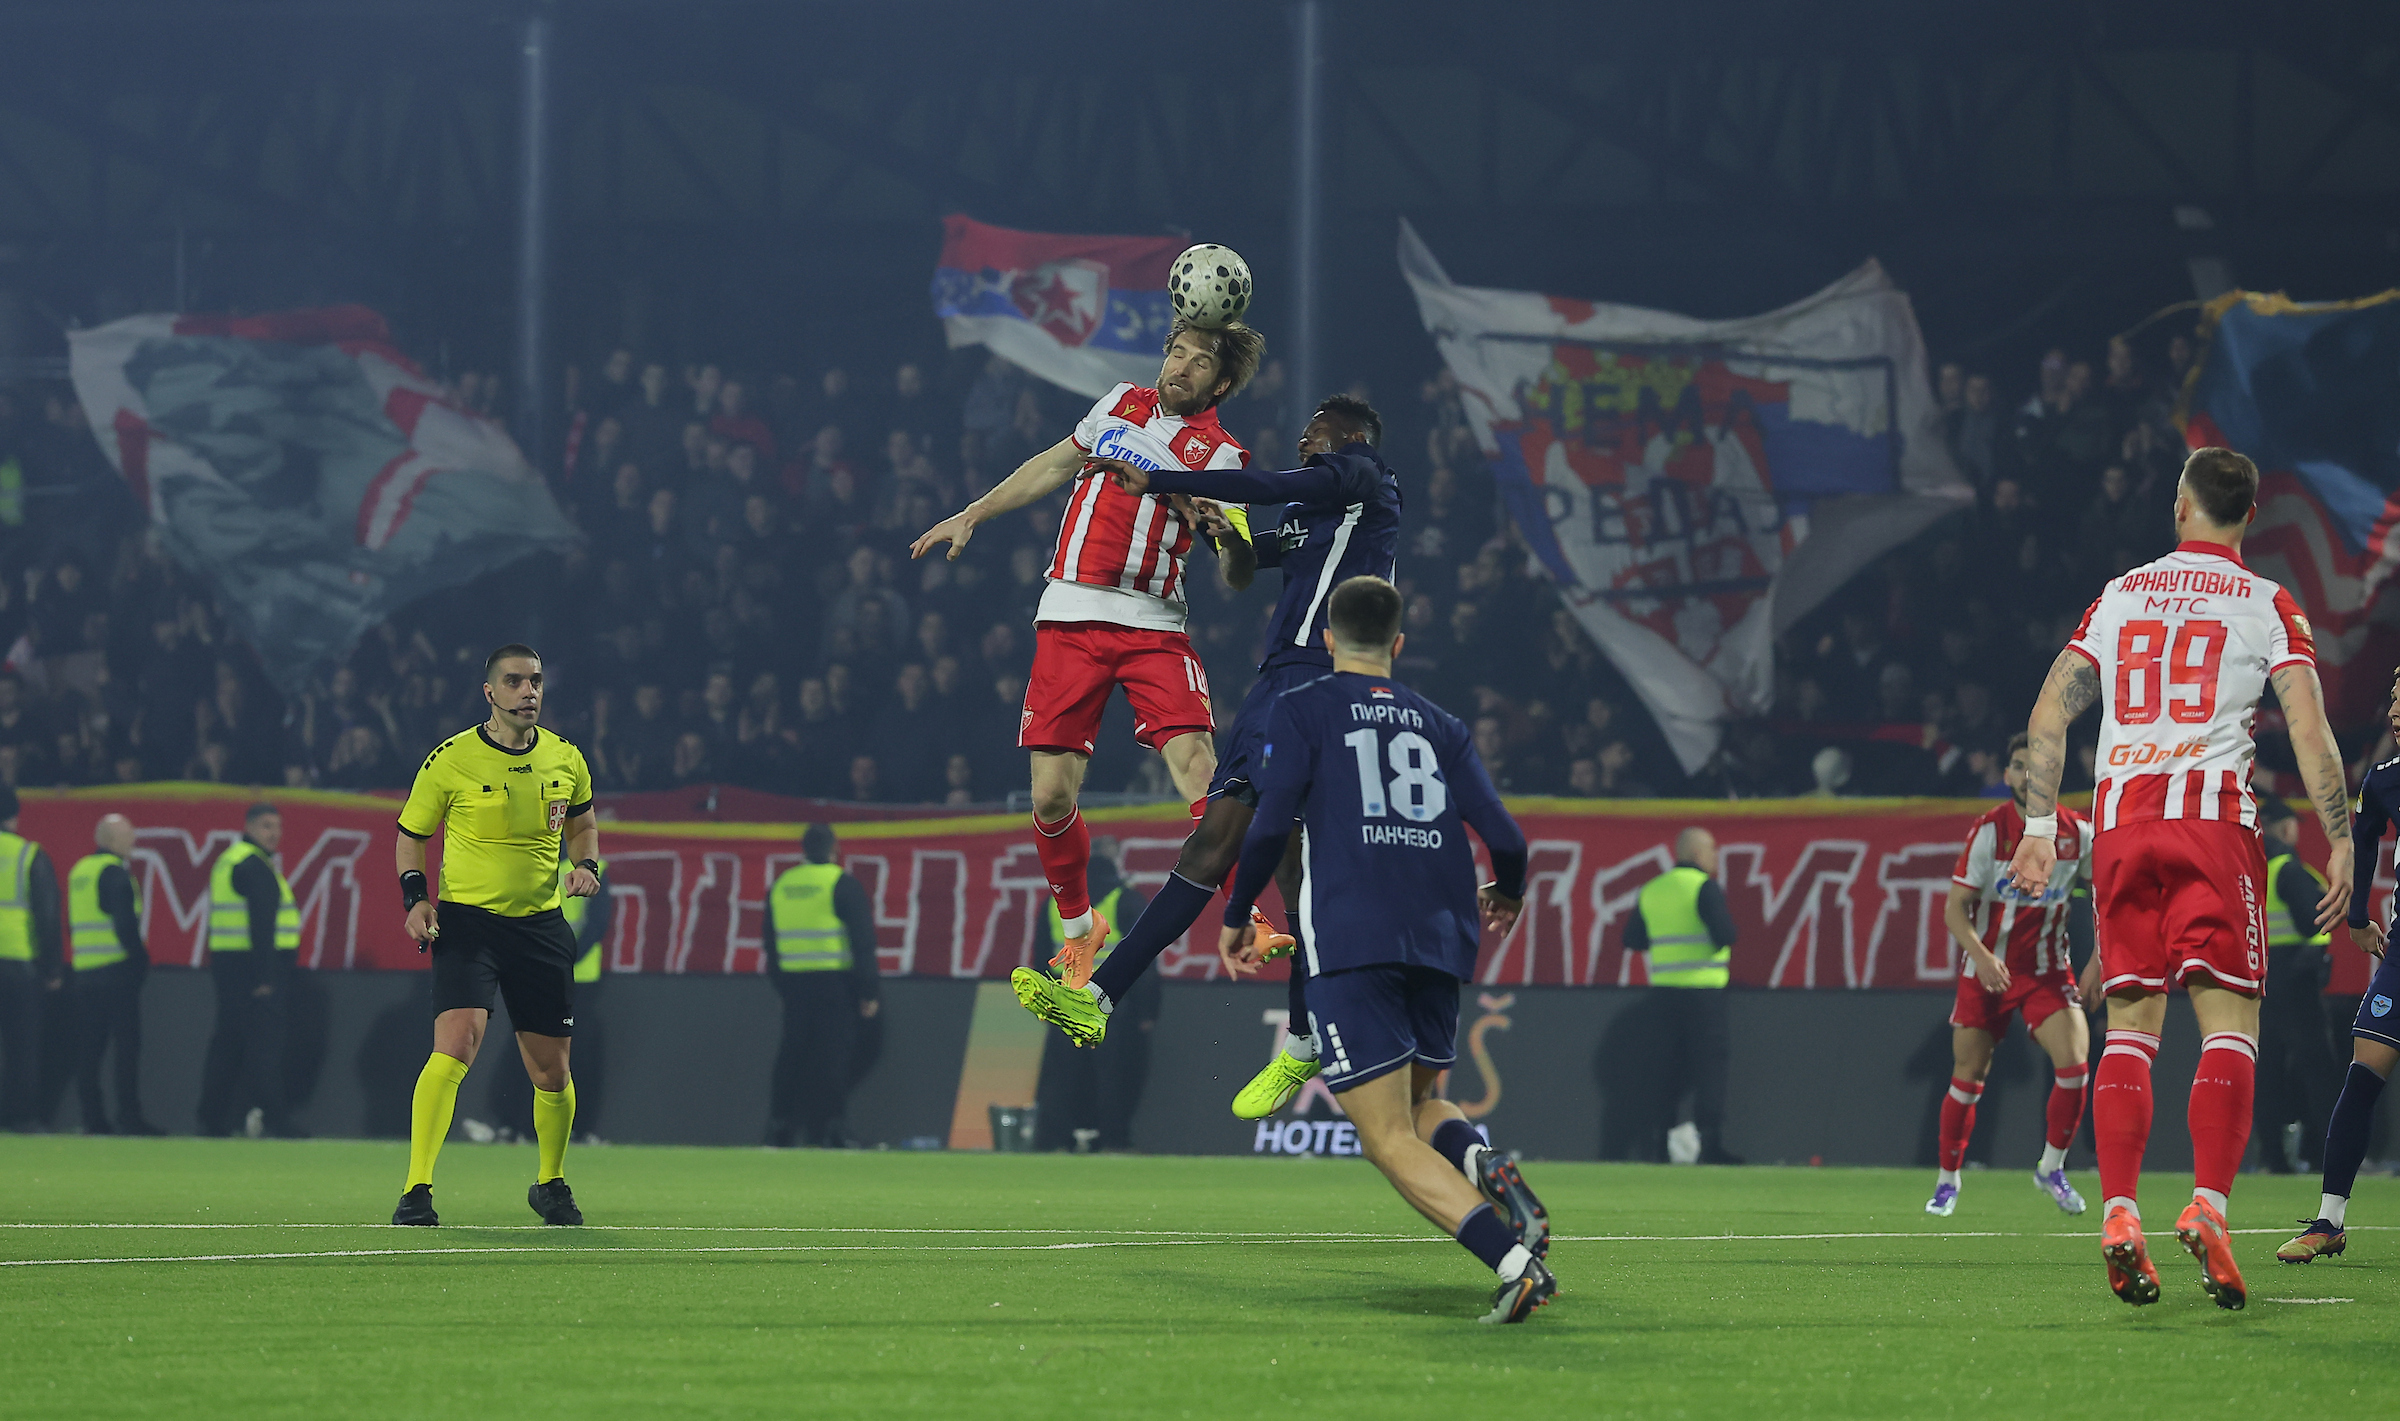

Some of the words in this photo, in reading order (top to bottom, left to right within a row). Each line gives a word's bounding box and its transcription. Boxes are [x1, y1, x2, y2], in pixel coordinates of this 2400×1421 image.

[2118, 570, 2251, 598] АРНАУТОВИЋ
[1183, 655, 1209, 695] 10
[2115, 620, 2228, 725] 89
[1350, 702, 1423, 729] ПИРГИЋ
[1344, 727, 1446, 823] 18
[1361, 824, 1443, 849] ПАНЧЕВО
[1254, 1120, 1362, 1155] HOTE
